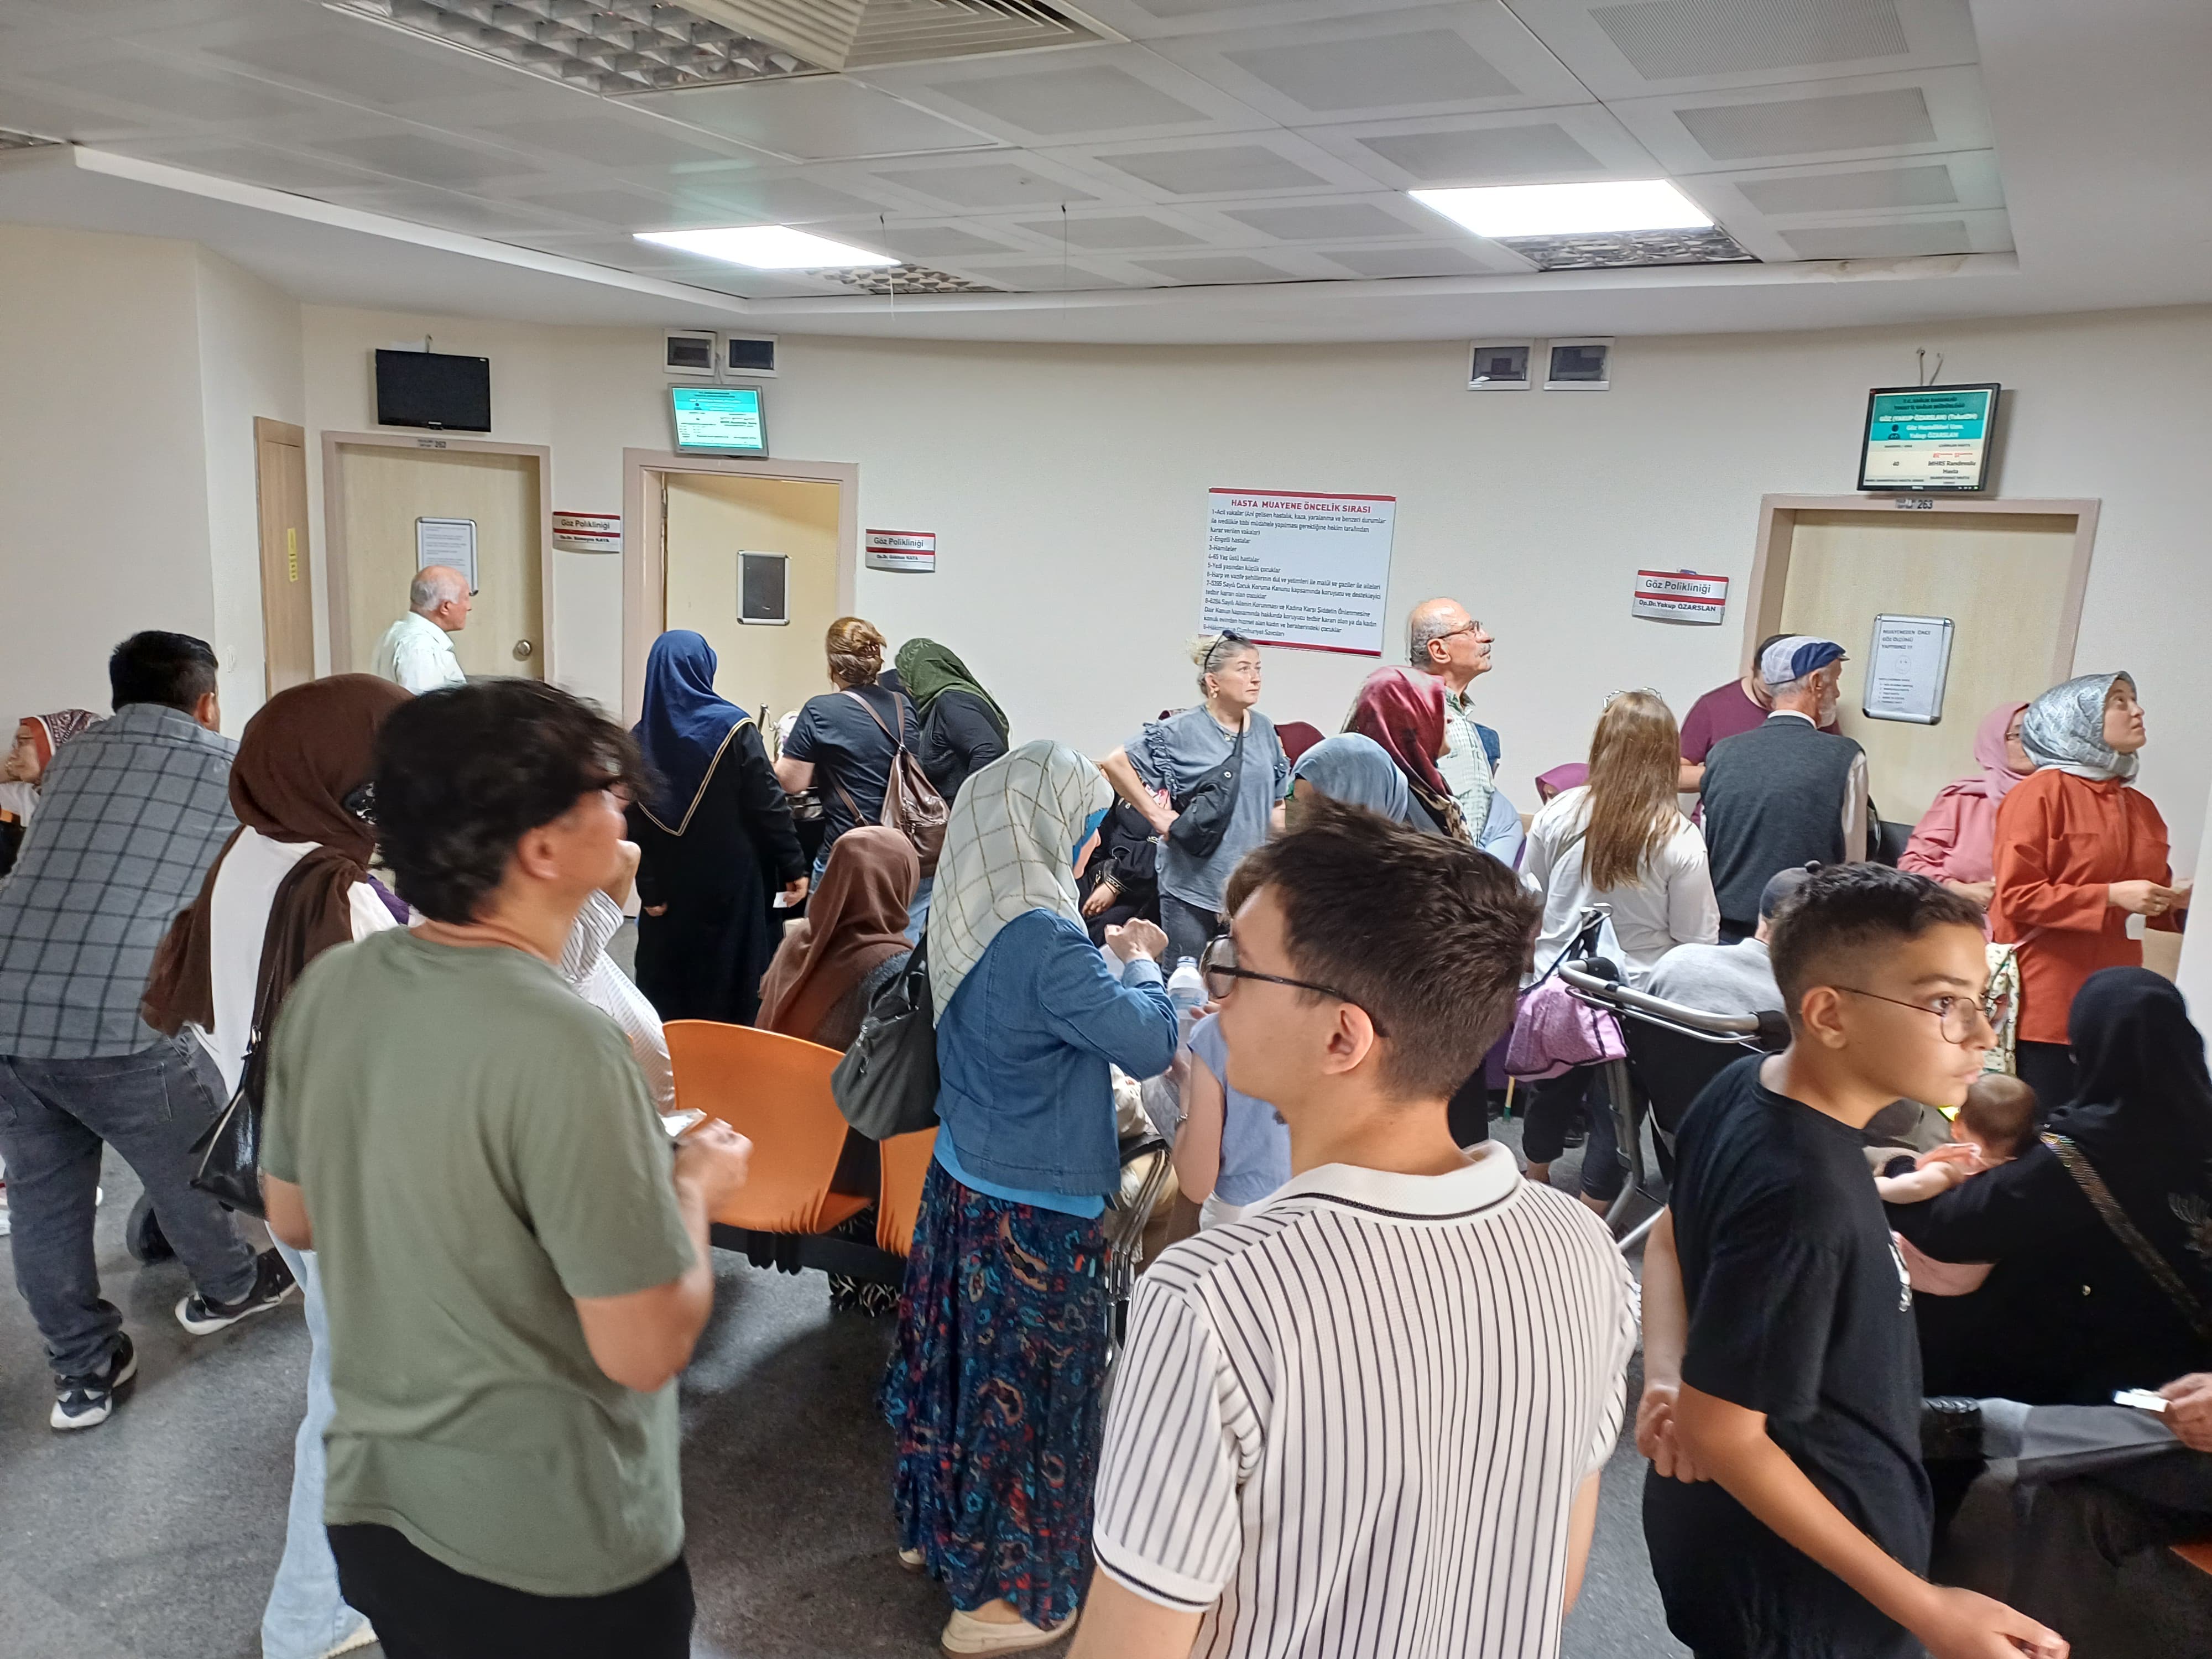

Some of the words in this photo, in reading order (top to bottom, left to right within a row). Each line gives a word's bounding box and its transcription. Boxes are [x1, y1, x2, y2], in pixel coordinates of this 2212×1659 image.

[1232, 499, 1258, 508] HASTA
[1262, 501, 1302, 510] MUAYENE
[1304, 502, 1340, 512] ÖNCELİK
[1342, 505, 1371, 513] SIRASI
[1918, 500, 1933, 509] 263
[889, 538, 924, 548] Polikliniği
[1645, 580, 1662, 589] Göz
[1665, 581, 1711, 594] Polikliniği
